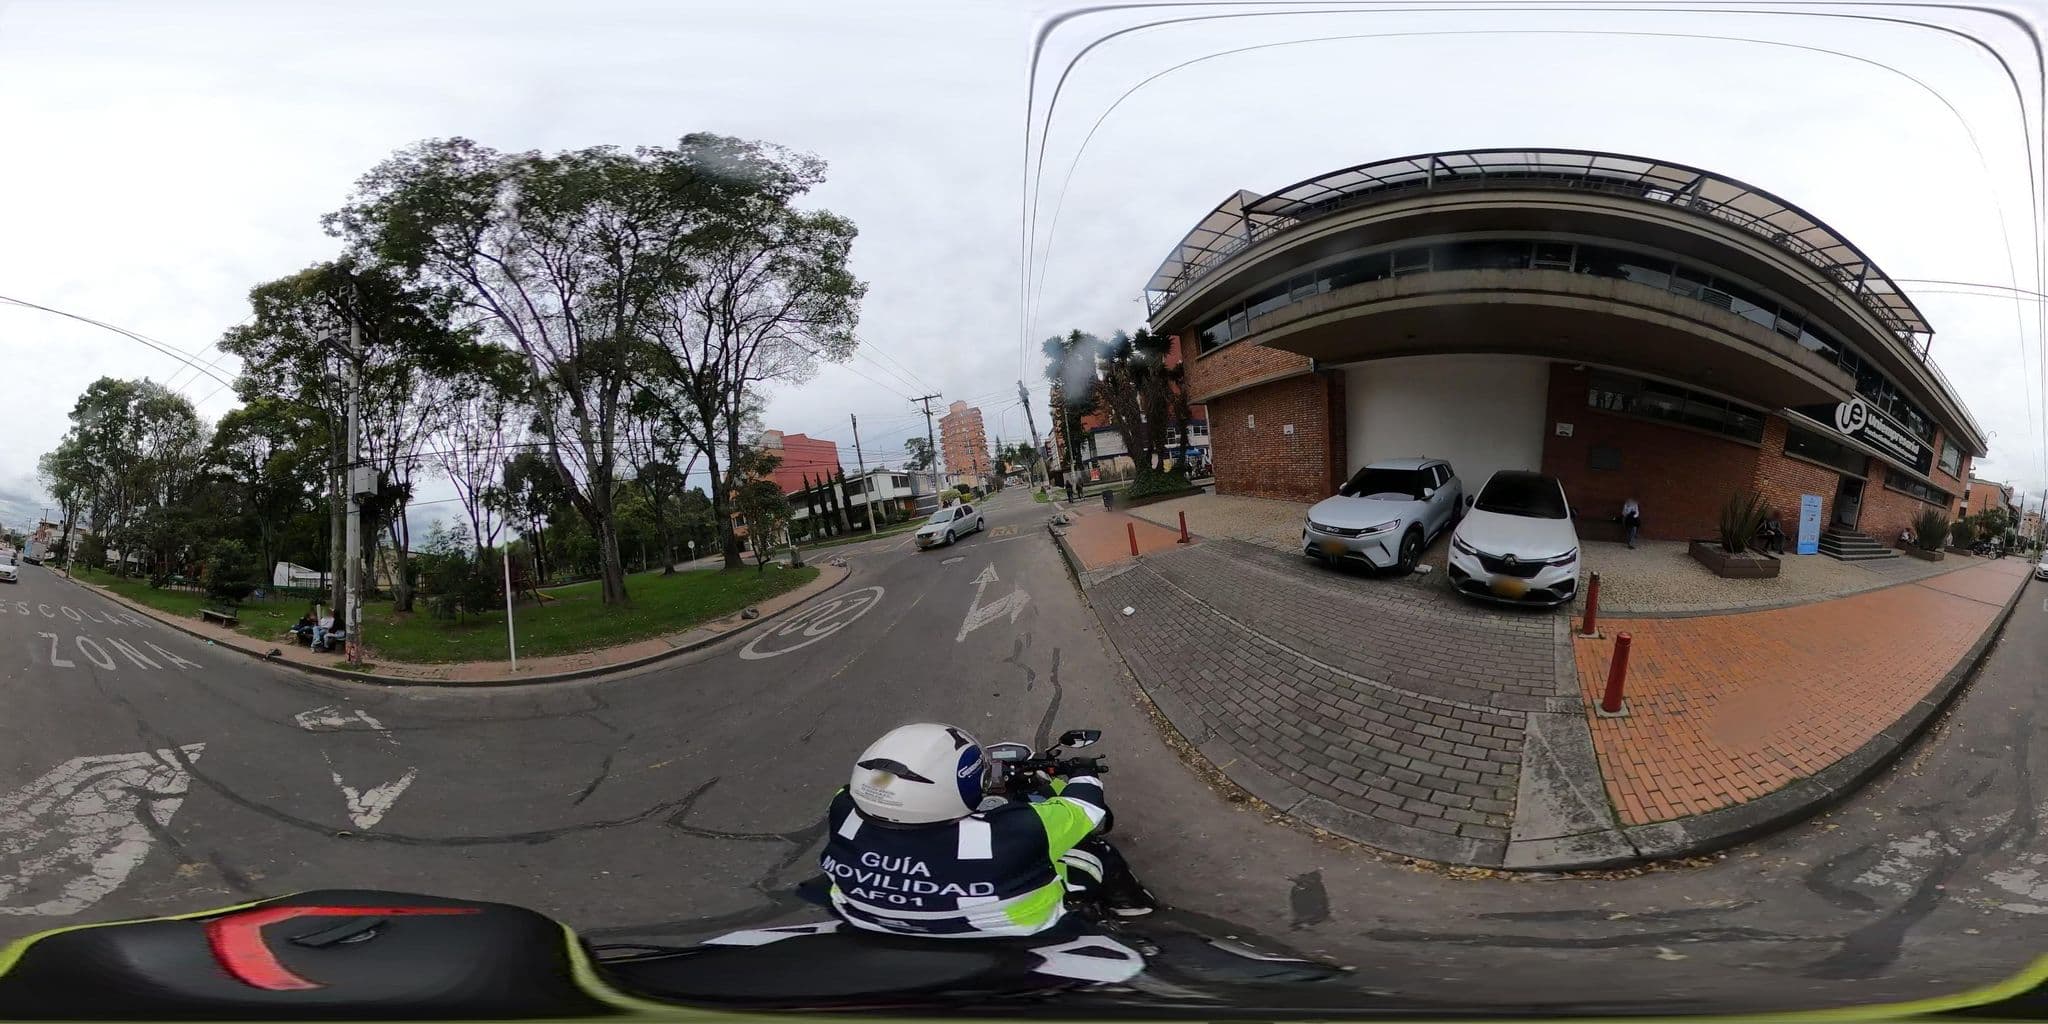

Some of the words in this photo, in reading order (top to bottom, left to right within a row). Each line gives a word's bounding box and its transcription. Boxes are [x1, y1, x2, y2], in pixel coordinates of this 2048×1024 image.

[37, 631, 204, 671] ZONA
[821, 855, 995, 897] MOVILIDAD
[860, 852, 931, 878] GUÍA
[850, 886, 923, 906] AF01
